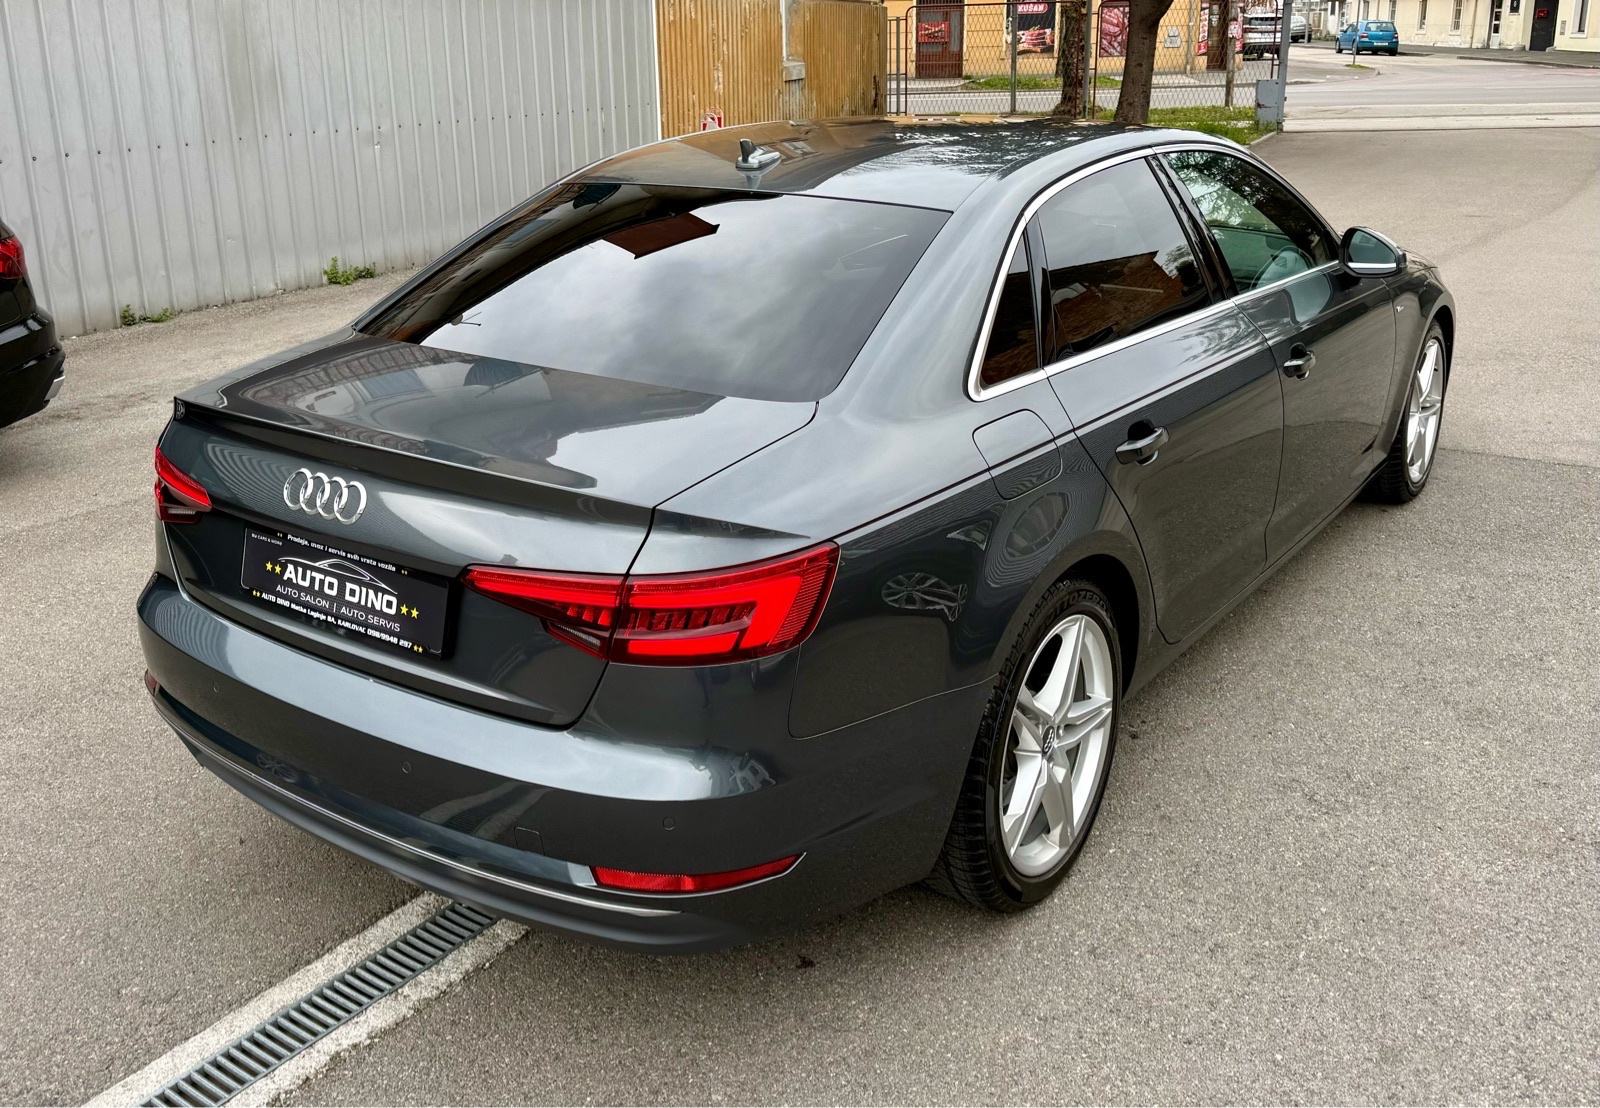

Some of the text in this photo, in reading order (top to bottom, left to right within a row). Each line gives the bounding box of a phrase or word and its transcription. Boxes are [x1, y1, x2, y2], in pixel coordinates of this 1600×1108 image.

[328, 546, 346, 557] servis
[347, 552, 359, 561] svih
[360, 557, 377, 566] vrsta
[378, 562, 396, 572] vozila
[276, 584, 401, 632] AUTO SALON AUTO SERVIS
[283, 563, 398, 615] AUTO DINO
[261, 592, 276, 603] AUTO
[276, 597, 290, 608] DINO
[337, 619, 366, 634] KARLOVAC
